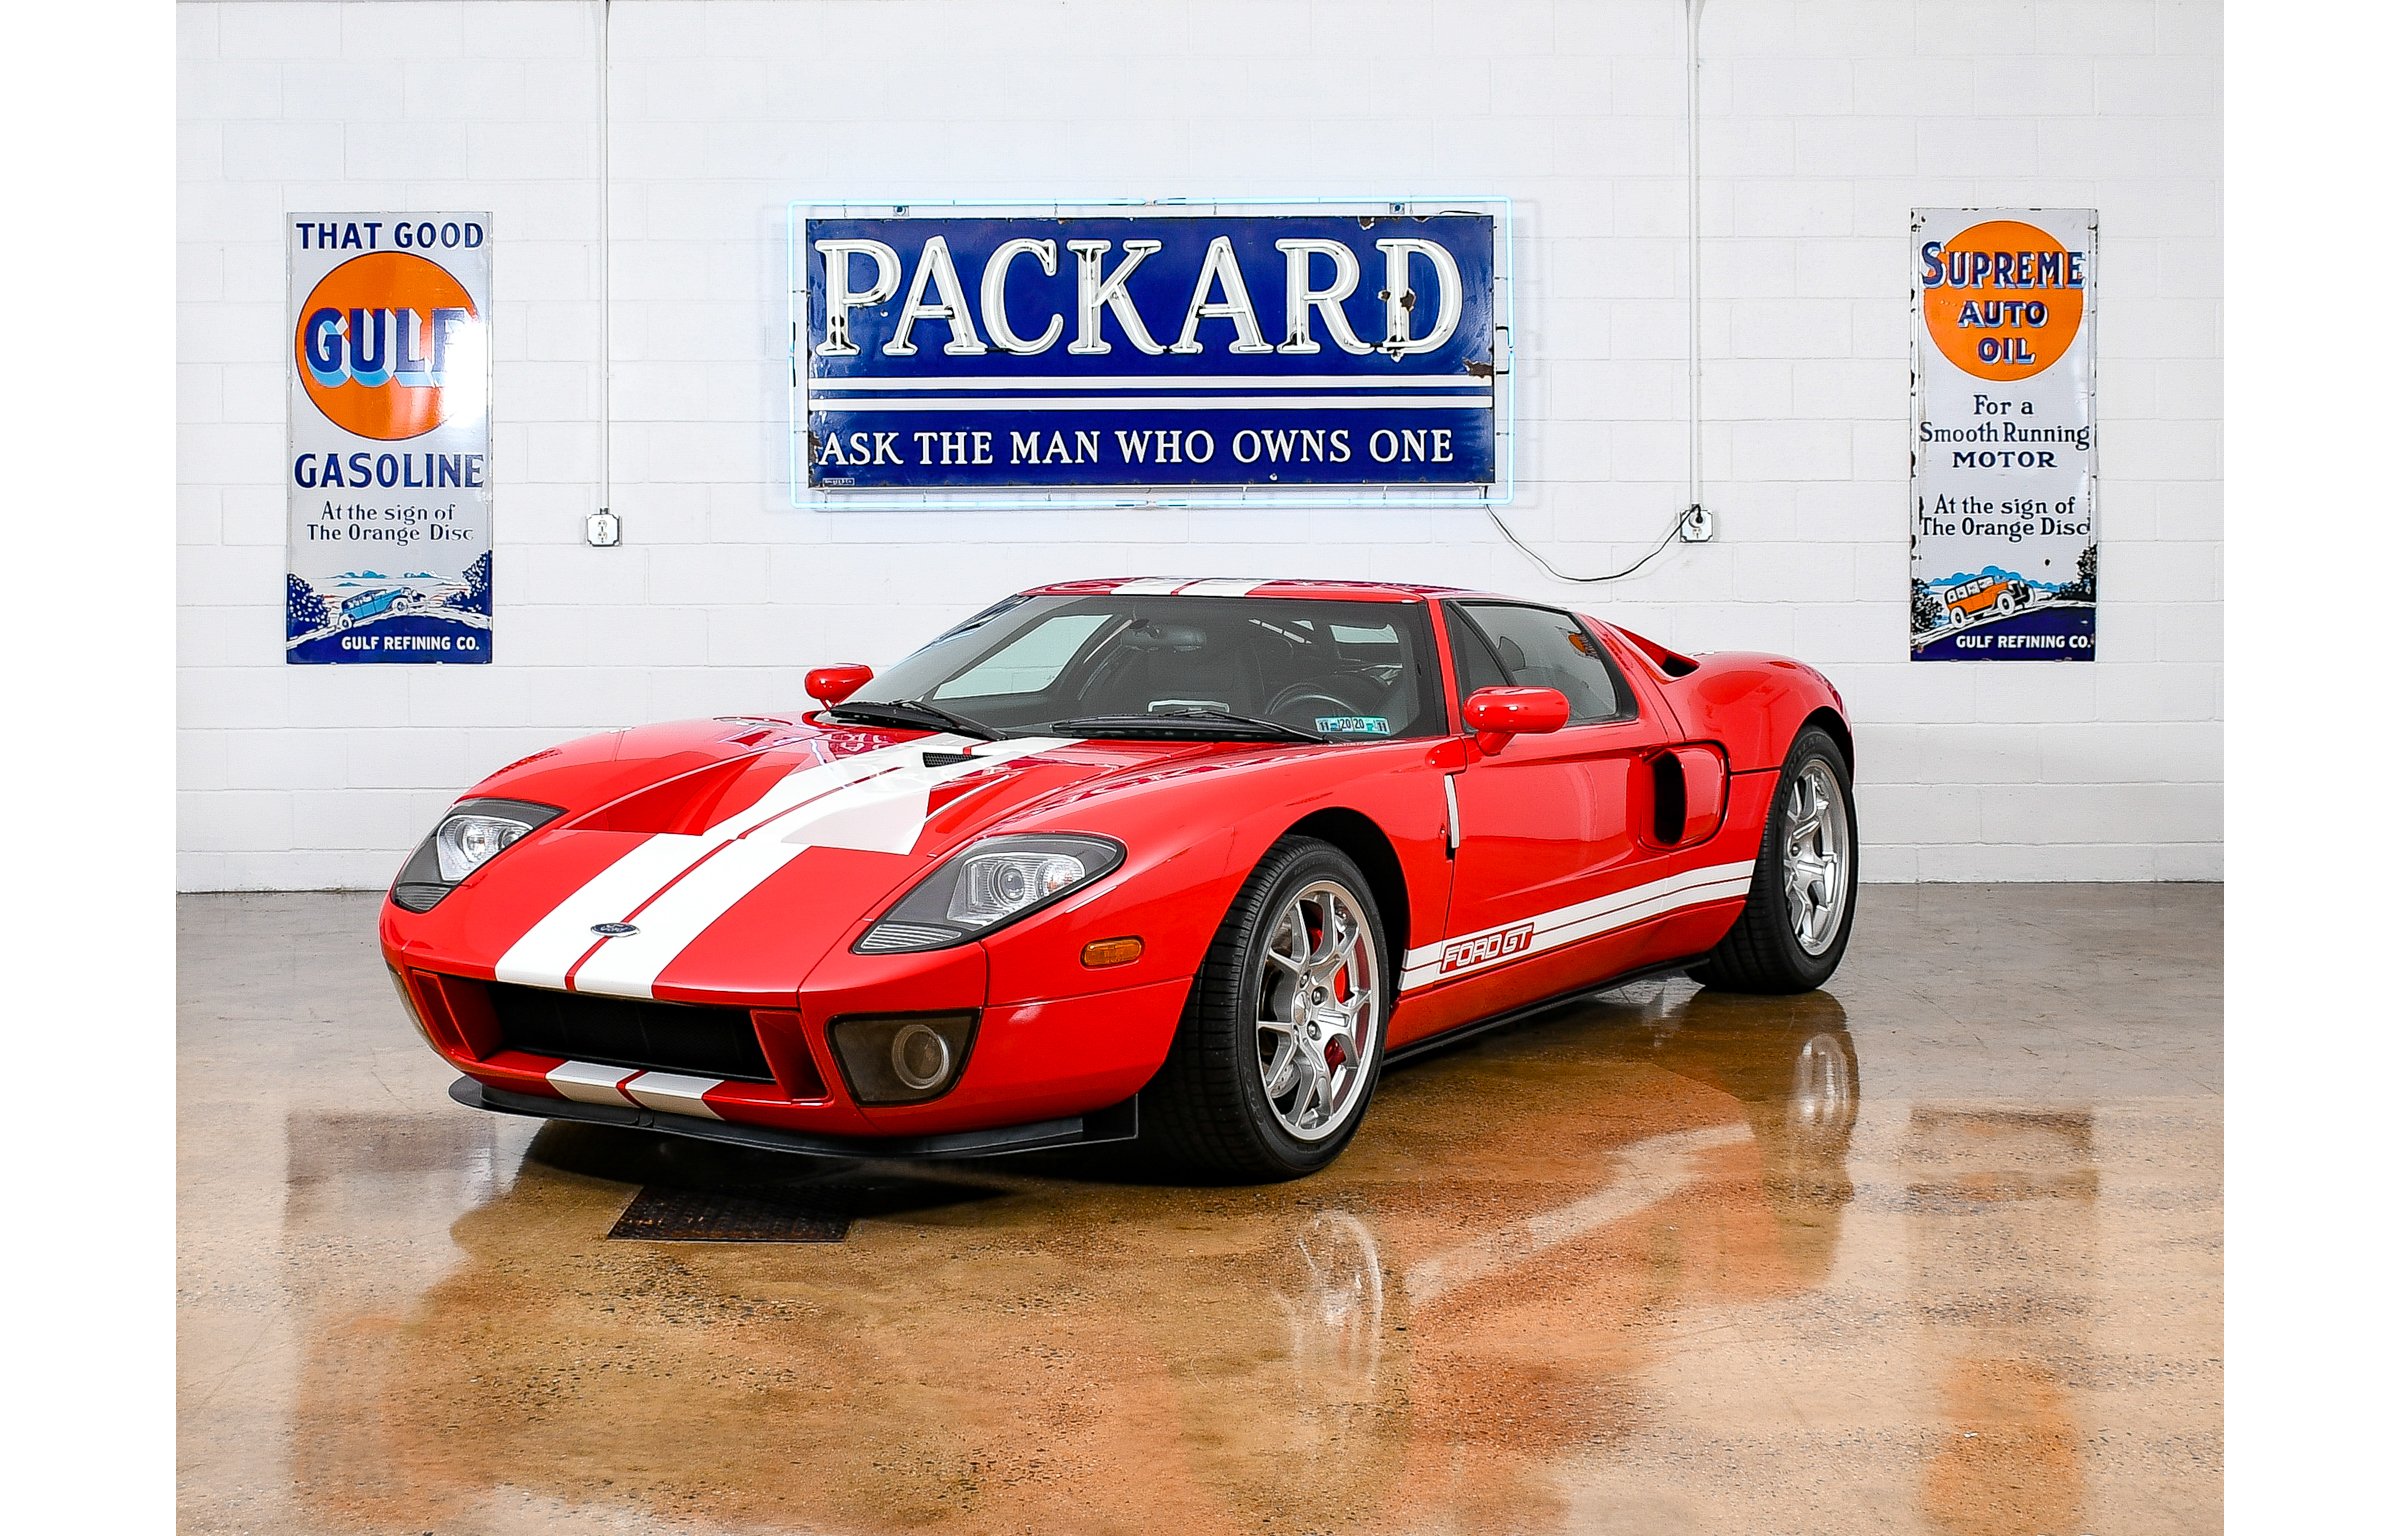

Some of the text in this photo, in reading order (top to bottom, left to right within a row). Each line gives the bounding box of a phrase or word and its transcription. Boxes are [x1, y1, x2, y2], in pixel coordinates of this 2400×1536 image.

[296, 222, 484, 249] THAT GOOD
[1920, 241, 2086, 289] SUPREME
[814, 235, 1463, 355] PACKARD
[1958, 301, 2048, 328] AUTO
[1977, 337, 2036, 365] OIL
[1973, 394, 2034, 415] For a
[818, 429, 1454, 465] ASK THE MAN WHO OWNS ONE
[1920, 421, 2091, 450] Smooth Running
[294, 453, 485, 488] GASOLINE
[1952, 451, 2058, 468] MOTOR
[321, 500, 456, 525] At the sign of
[1934, 493, 2076, 519] At the sign of
[307, 523, 474, 546] The Orange Disc
[1922, 517, 2090, 542] The Orange Disc
[341, 636, 480, 650] GULF REFINING CO.
[1956, 635, 2092, 649] GULF REFINING CO.
[1441, 925, 1533, 971] FORD GT
